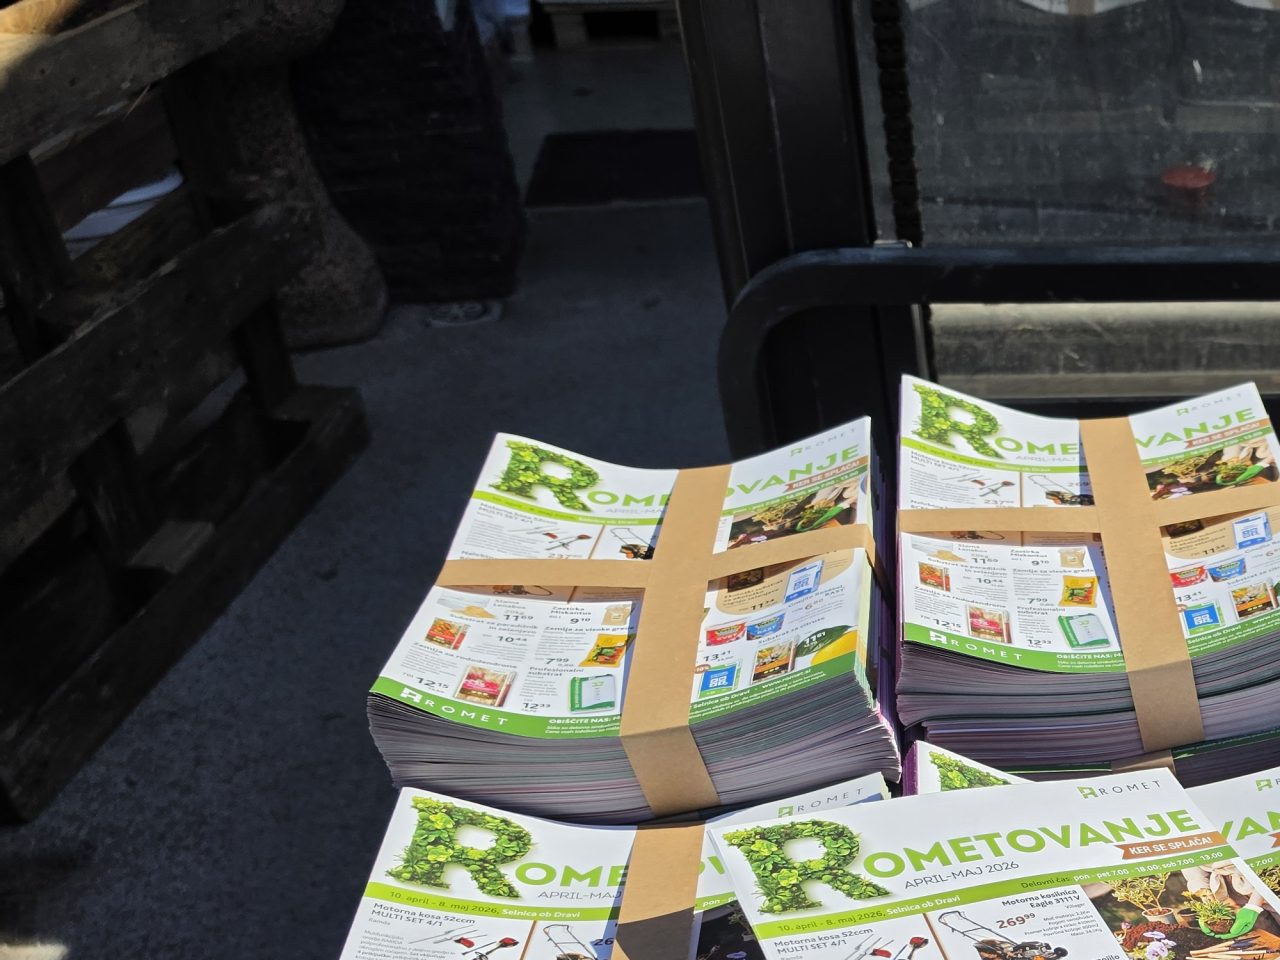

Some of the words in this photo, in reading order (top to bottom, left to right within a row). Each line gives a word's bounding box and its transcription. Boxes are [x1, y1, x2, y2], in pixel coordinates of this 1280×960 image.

[951, 638, 1023, 661] ROMET
[424, 699, 509, 726] ROMET
[1098, 780, 1161, 796] ROMET
[797, 787, 864, 813] ROMET
[1128, 843, 1153, 856] KER
[1154, 842, 1168, 852] SE
[1168, 835, 1213, 850] SPLAČA!
[722, 809, 1201, 915] ROMETOVANJE
[905, 866, 982, 890] APRIL-MAJ
[986, 860, 1020, 875] 2026
[1021, 877, 1054, 889] Delovni
[537, 890, 623, 900] APRIL-MAJ
[1001, 895, 1038, 907] Motorna
[1039, 888, 1077, 900] kosilnica
[1030, 899, 1053, 910] Eagle
[371, 909, 405, 921] MULTI
[405, 915, 424, 924] SET
[373, 903, 417, 917] Motorna
[419, 911, 441, 921] kosa
[443, 915, 476, 924] 52ccm
[501, 908, 537, 917] Selnica
[554, 910, 580, 919] Dravi
[838, 915, 857, 926] maj
[859, 910, 886, 921] 2026,
[886, 903, 920, 915] Selnica
[935, 895, 961, 906] Dravi
[774, 936, 817, 948] Motorna
[818, 932, 840, 942] kosa
[842, 927, 873, 938] 52ccm
[777, 944, 804, 955] MULTI
[806, 942, 827, 952] SET
